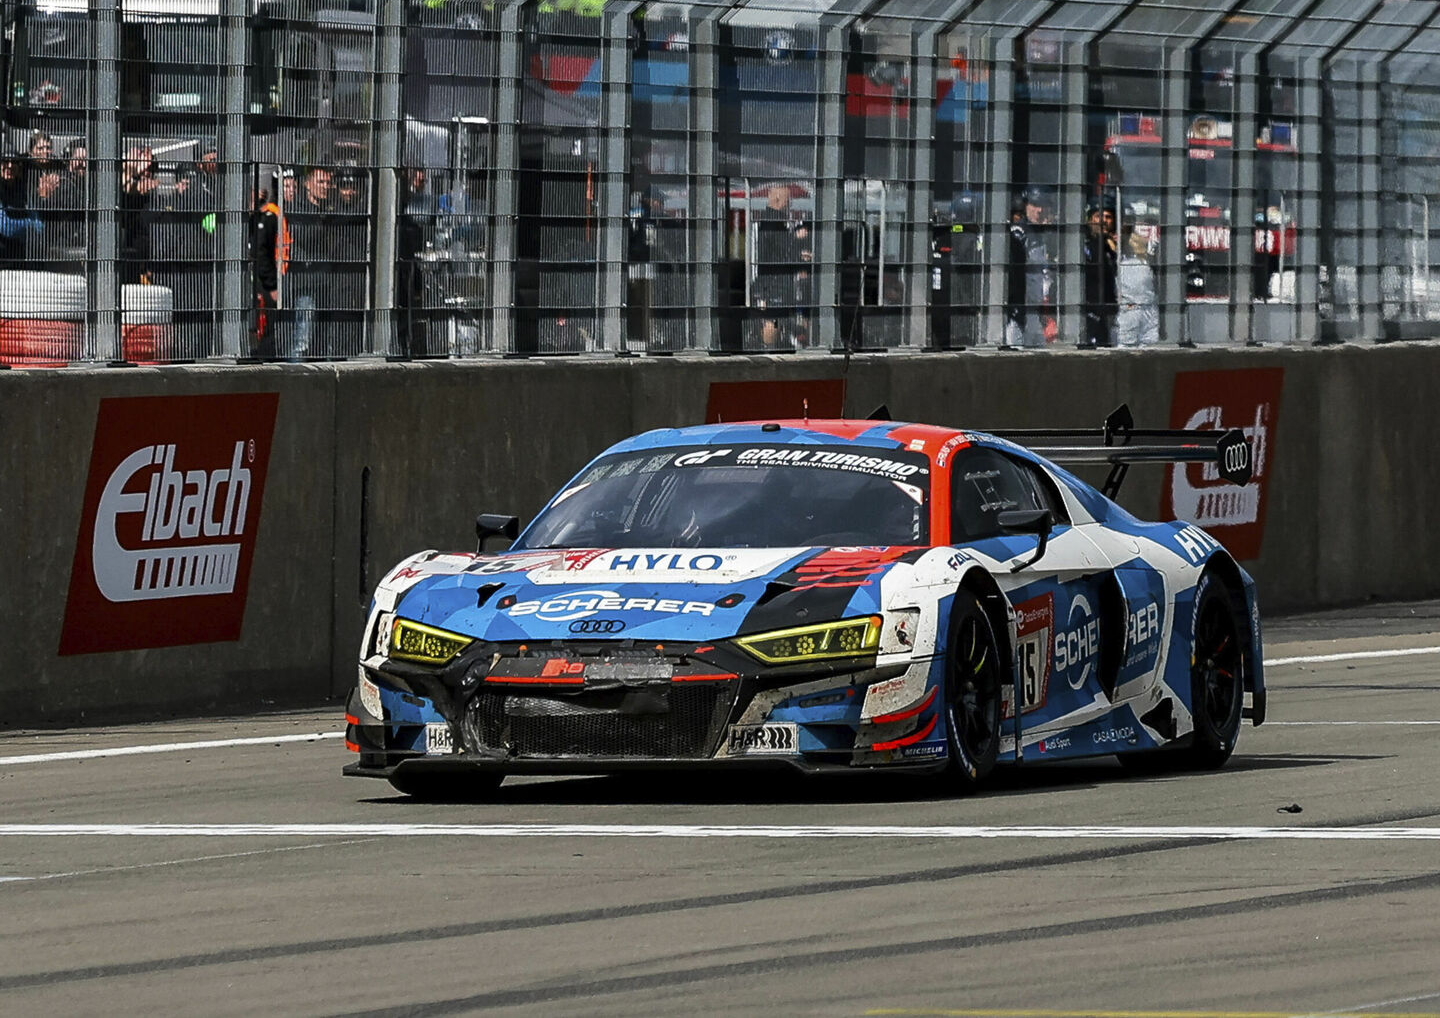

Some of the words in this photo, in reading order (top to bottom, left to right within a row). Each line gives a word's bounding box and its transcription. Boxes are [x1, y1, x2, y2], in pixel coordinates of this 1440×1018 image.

[736, 448, 810, 462] GRAN
[810, 450, 918, 476] TURISMO
[792, 460, 839, 470] DRIVING
[841, 465, 907, 481] SIMULATOR
[93, 441, 251, 602] Eibach
[610, 554, 722, 570] HYLO
[508, 594, 715, 617] SCHERER
[1018, 642, 1036, 705] 15
[732, 727, 767, 749] H&R
[905, 746, 943, 755] MICHELIN
